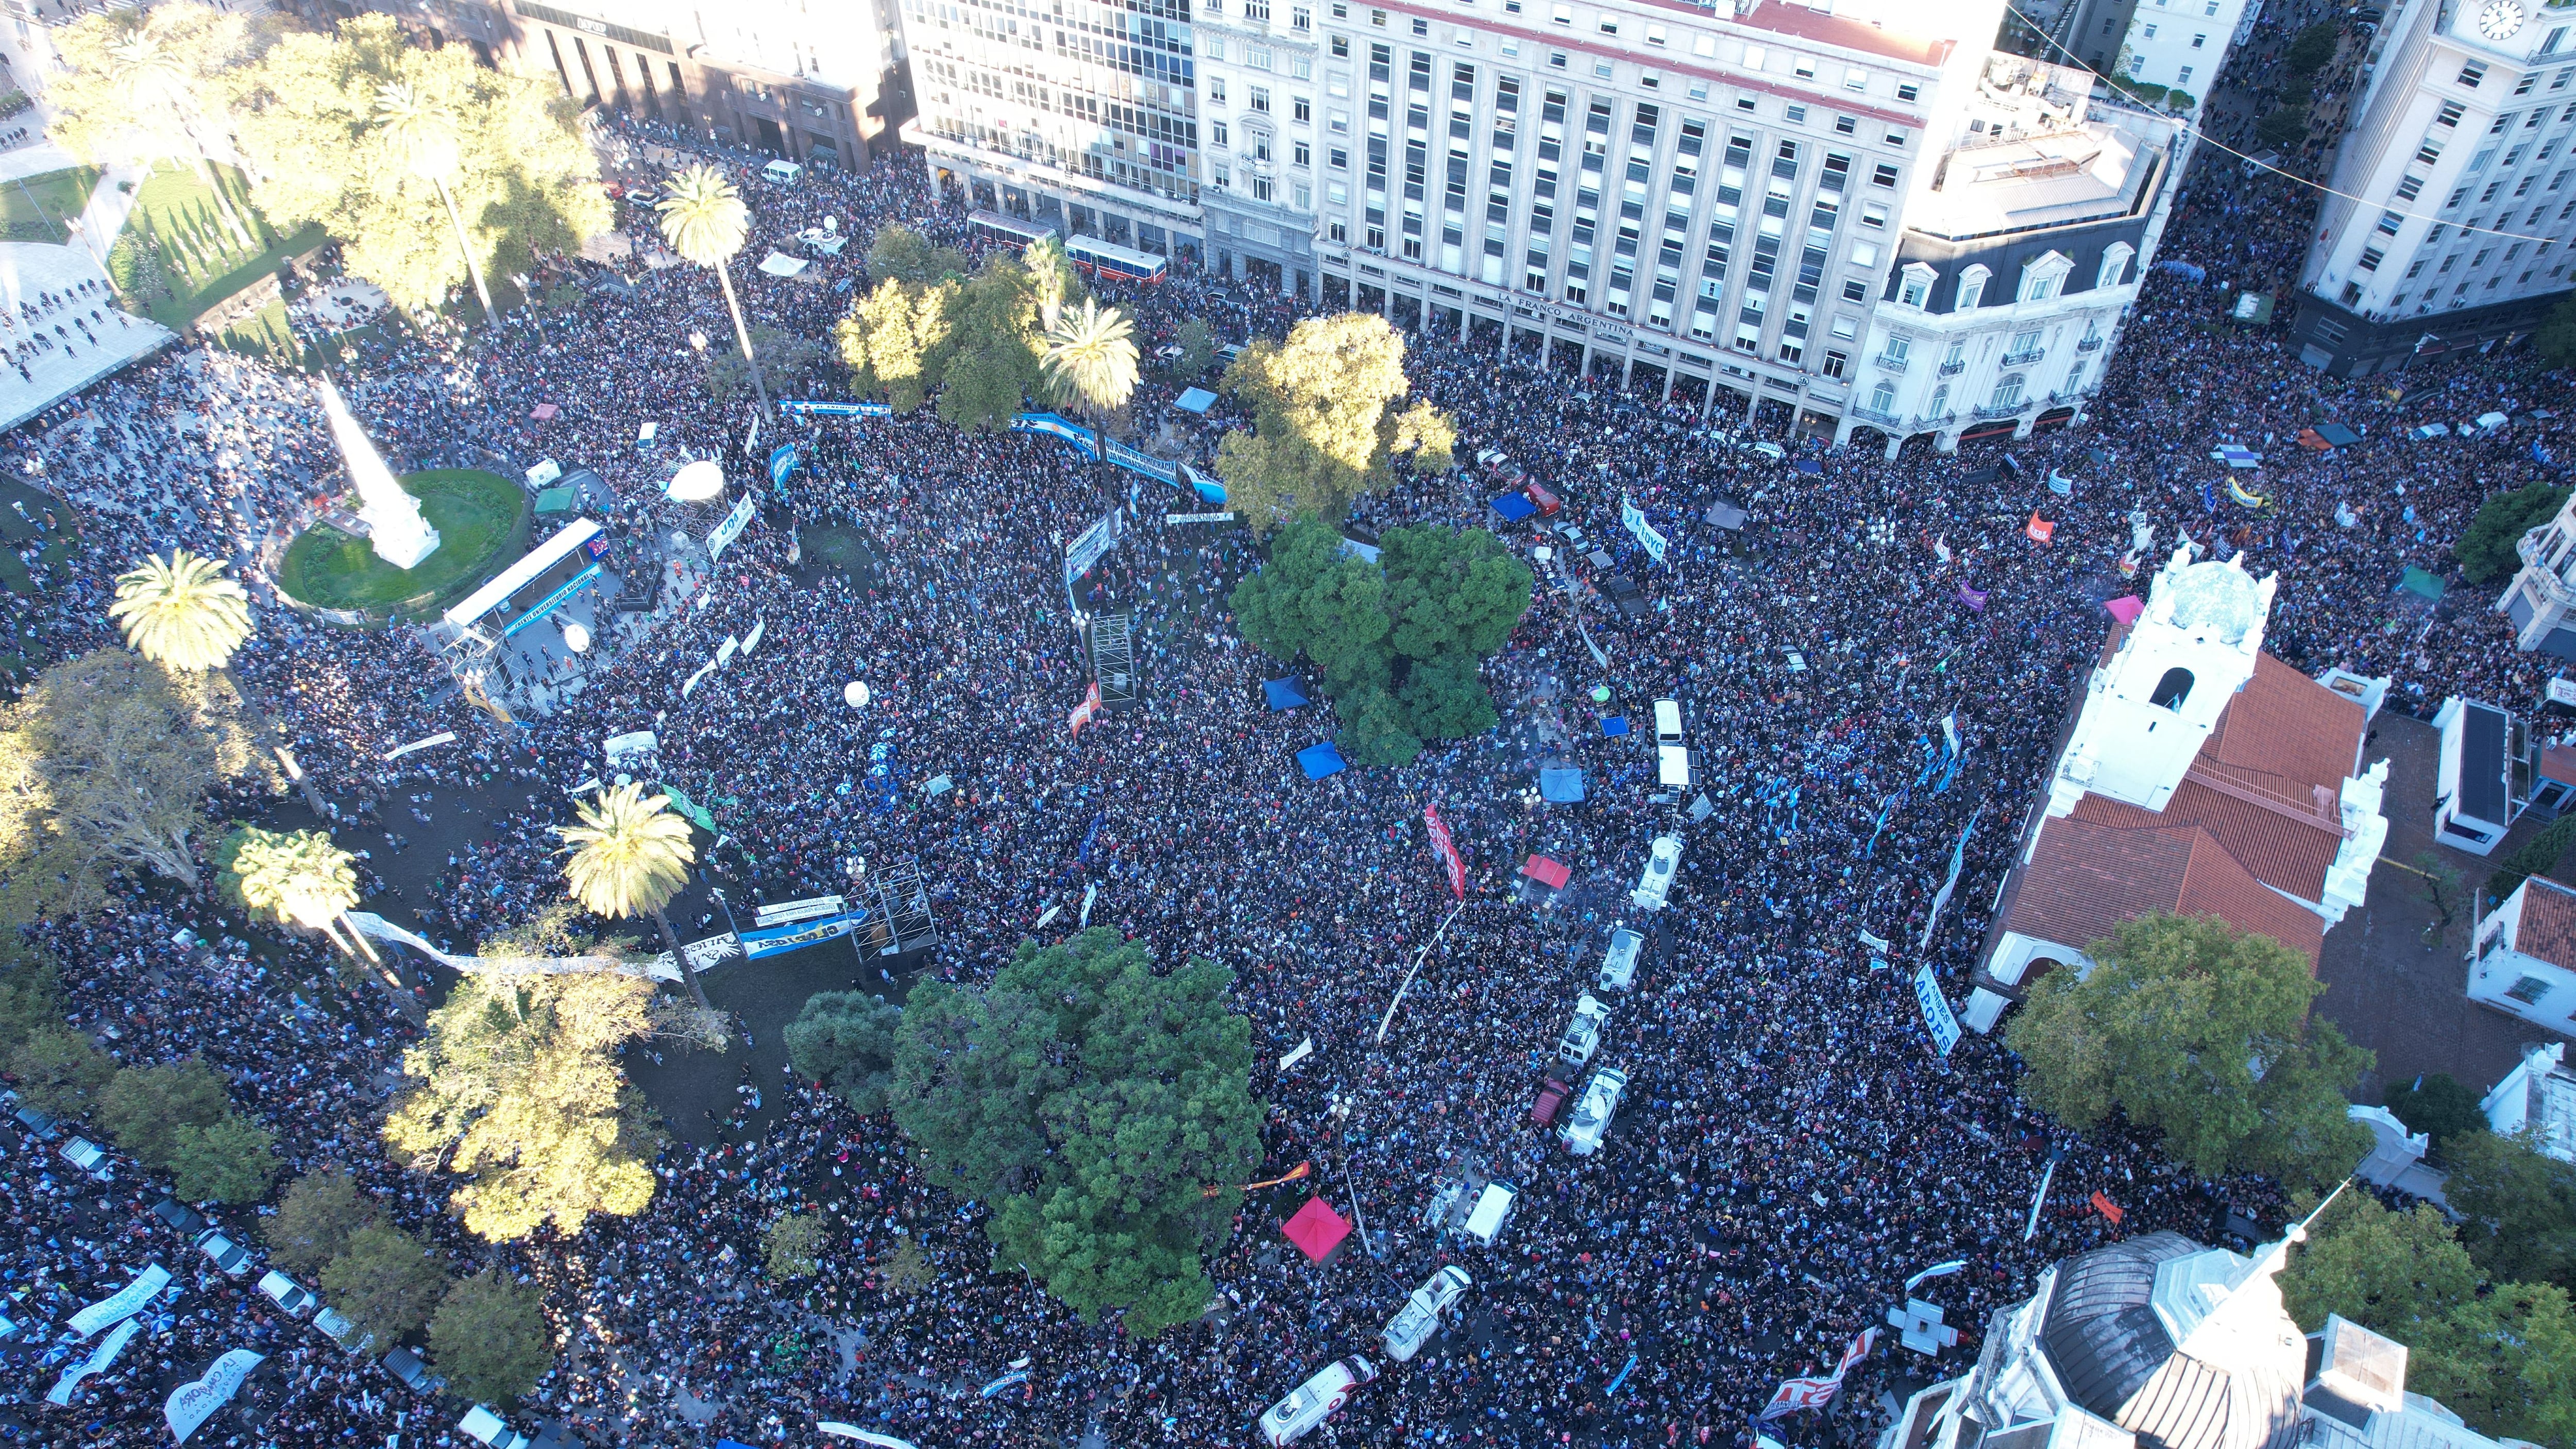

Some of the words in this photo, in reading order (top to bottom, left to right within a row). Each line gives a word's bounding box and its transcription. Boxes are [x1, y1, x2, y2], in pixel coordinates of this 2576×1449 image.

[1498, 293, 1511, 303] LA
[1519, 299, 1561, 316] FRANCO
[1568, 313, 1634, 336] ARGENTINA
[1106, 440, 1114, 450] 40
[1132, 450, 1140, 461] DE
[1140, 453, 1176, 472] DEMOCRACIA
[1107, 450, 1118, 461] LOS
[532, 590, 567, 618] UNIVERSITARIO
[567, 572, 590, 592] NACIONAL
[1916, 980, 1950, 1052] APOPS
[1931, 985, 1950, 1024] ANSES
